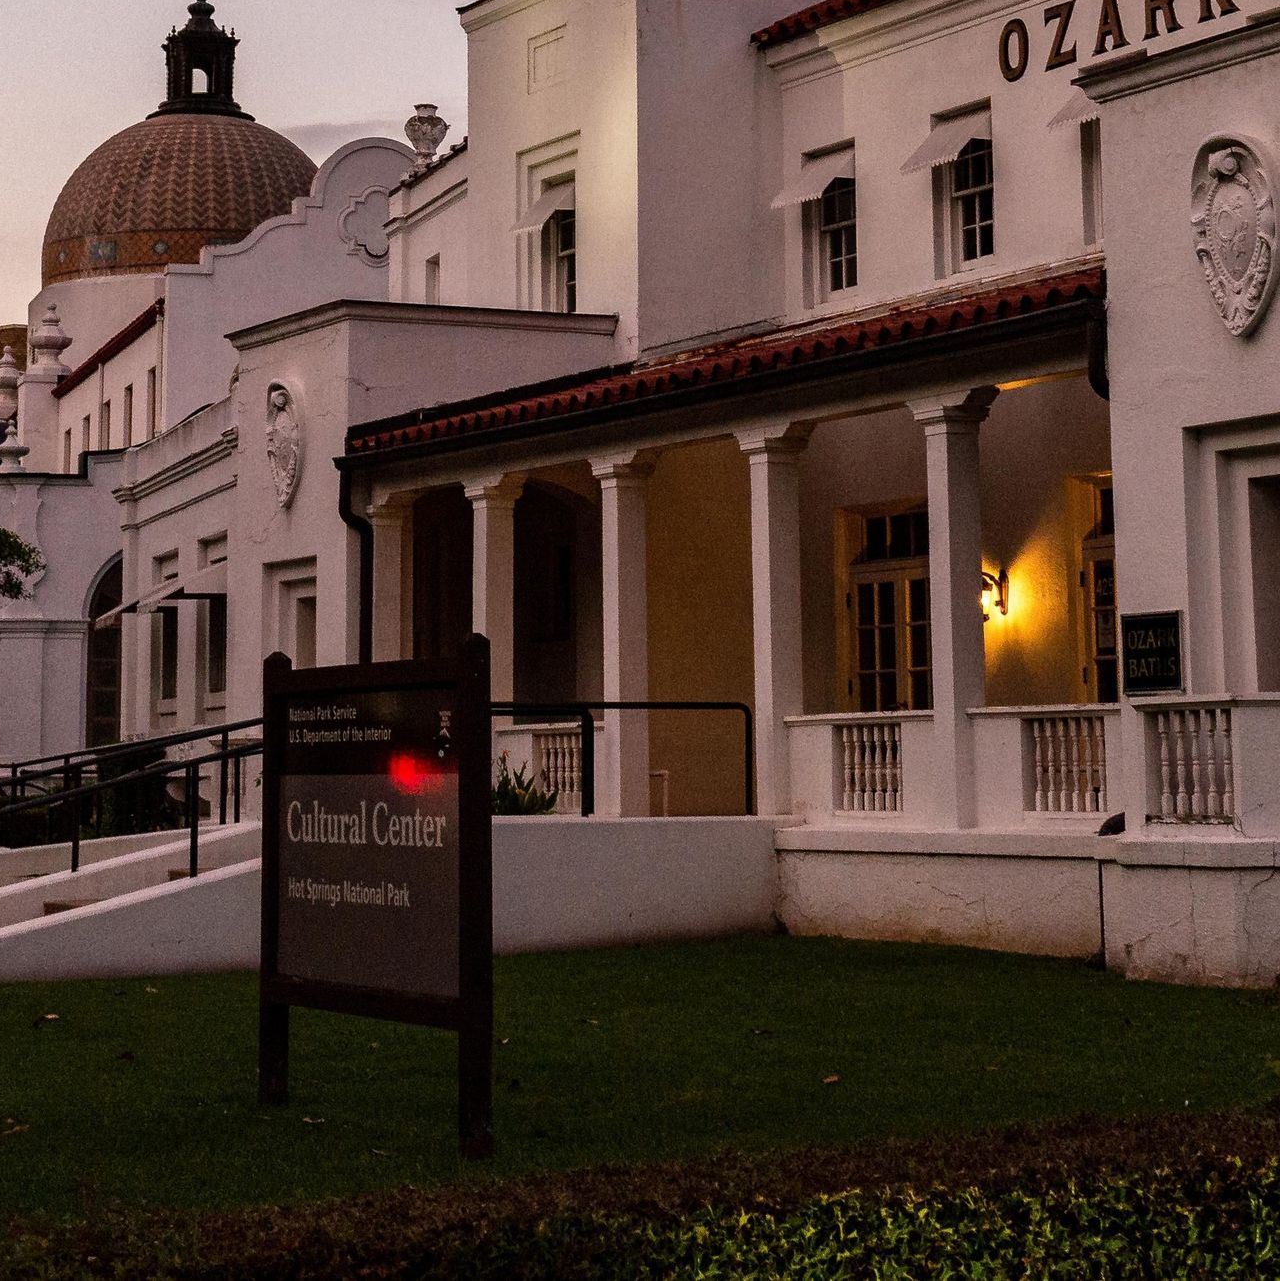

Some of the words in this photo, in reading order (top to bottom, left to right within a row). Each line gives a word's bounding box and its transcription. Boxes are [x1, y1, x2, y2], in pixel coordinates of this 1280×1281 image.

[1127, 628, 1176, 650] OZARK
[289, 706, 315, 722] National
[317, 706, 331, 721] Park
[333, 704, 357, 720] Service
[289, 728, 302, 743] U.S.
[303, 728, 342, 747] Department
[343, 726, 351, 742] of
[352, 726, 363, 741] the
[365, 725, 392, 741] Interior
[286, 800, 368, 844] Cultural
[372, 801, 447, 847] Center
[288, 877, 306, 899] Hot
[306, 878, 341, 907] Springs
[343, 880, 385, 905] National
[387, 882, 410, 907] Park
